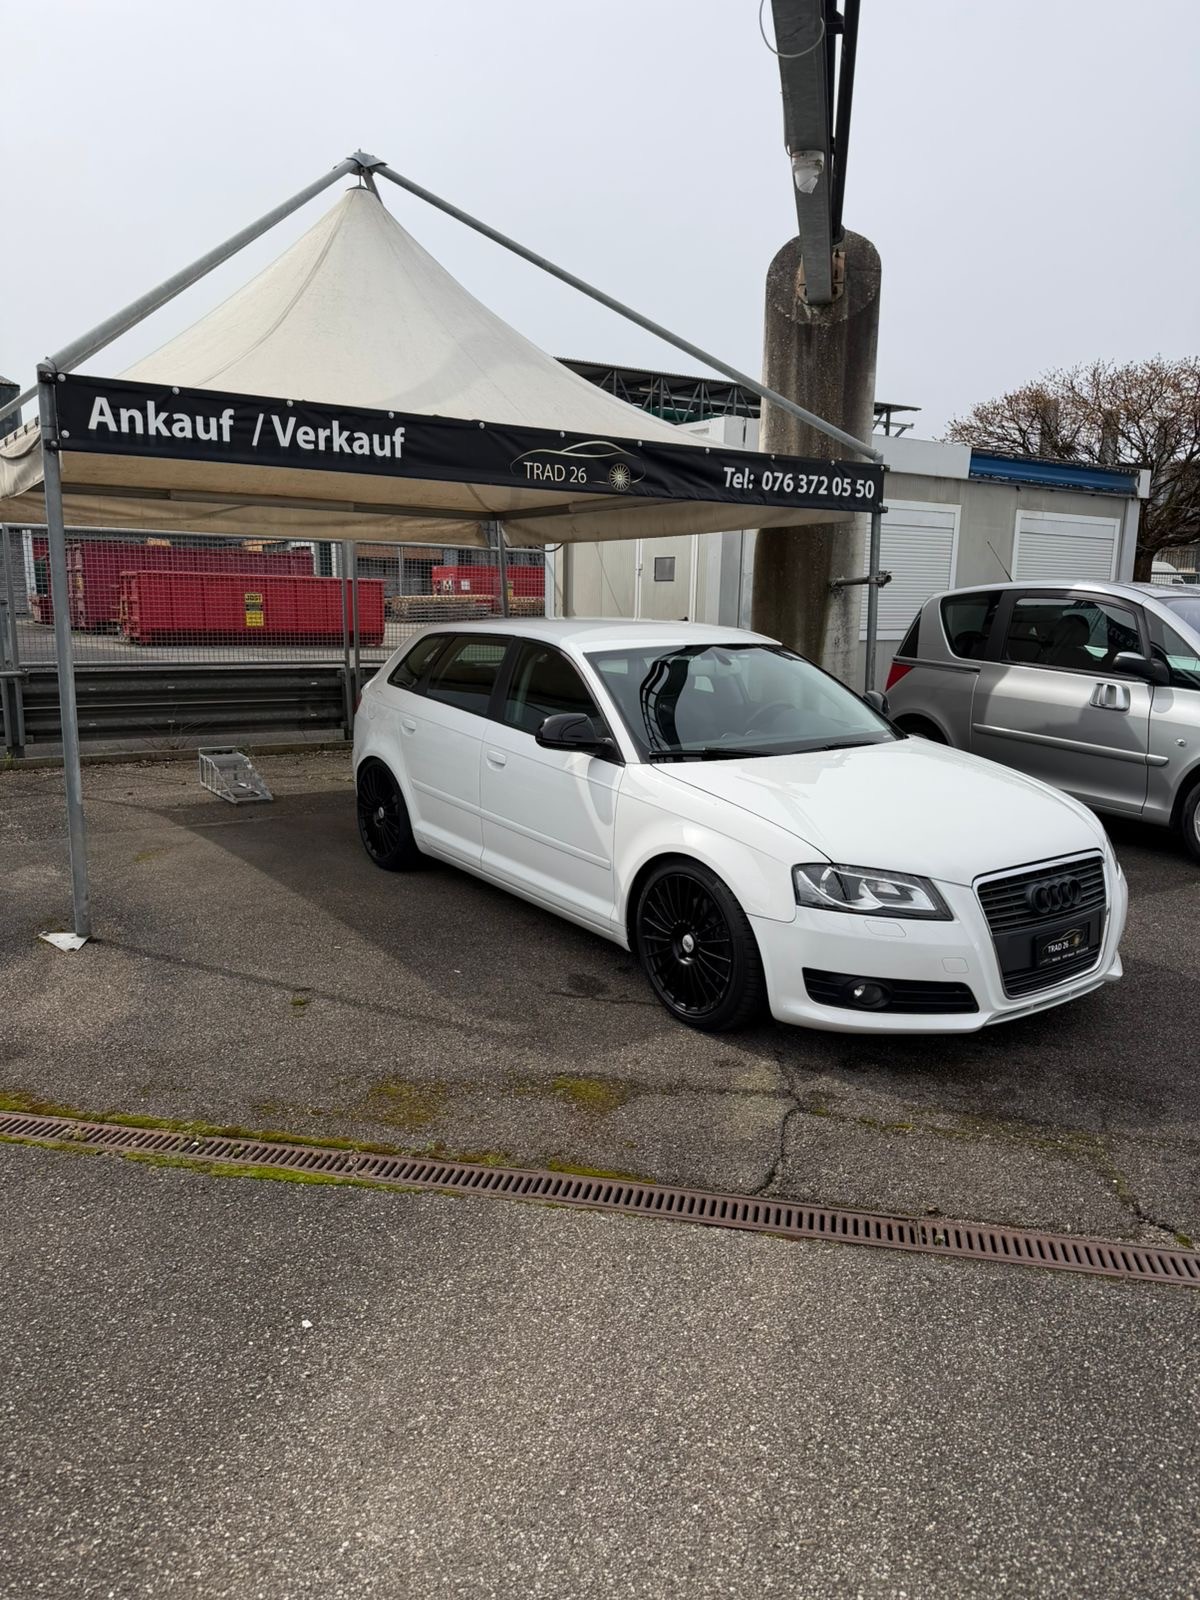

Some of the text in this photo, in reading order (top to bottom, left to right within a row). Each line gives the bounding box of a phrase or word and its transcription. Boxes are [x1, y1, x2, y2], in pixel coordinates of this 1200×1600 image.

[88, 396, 235, 442] Ankauf
[523, 462, 587, 483] TRAD 26
[723, 466, 875, 498] Tel: 076 372 05 50
[1048, 943, 1062, 953] TRAD
